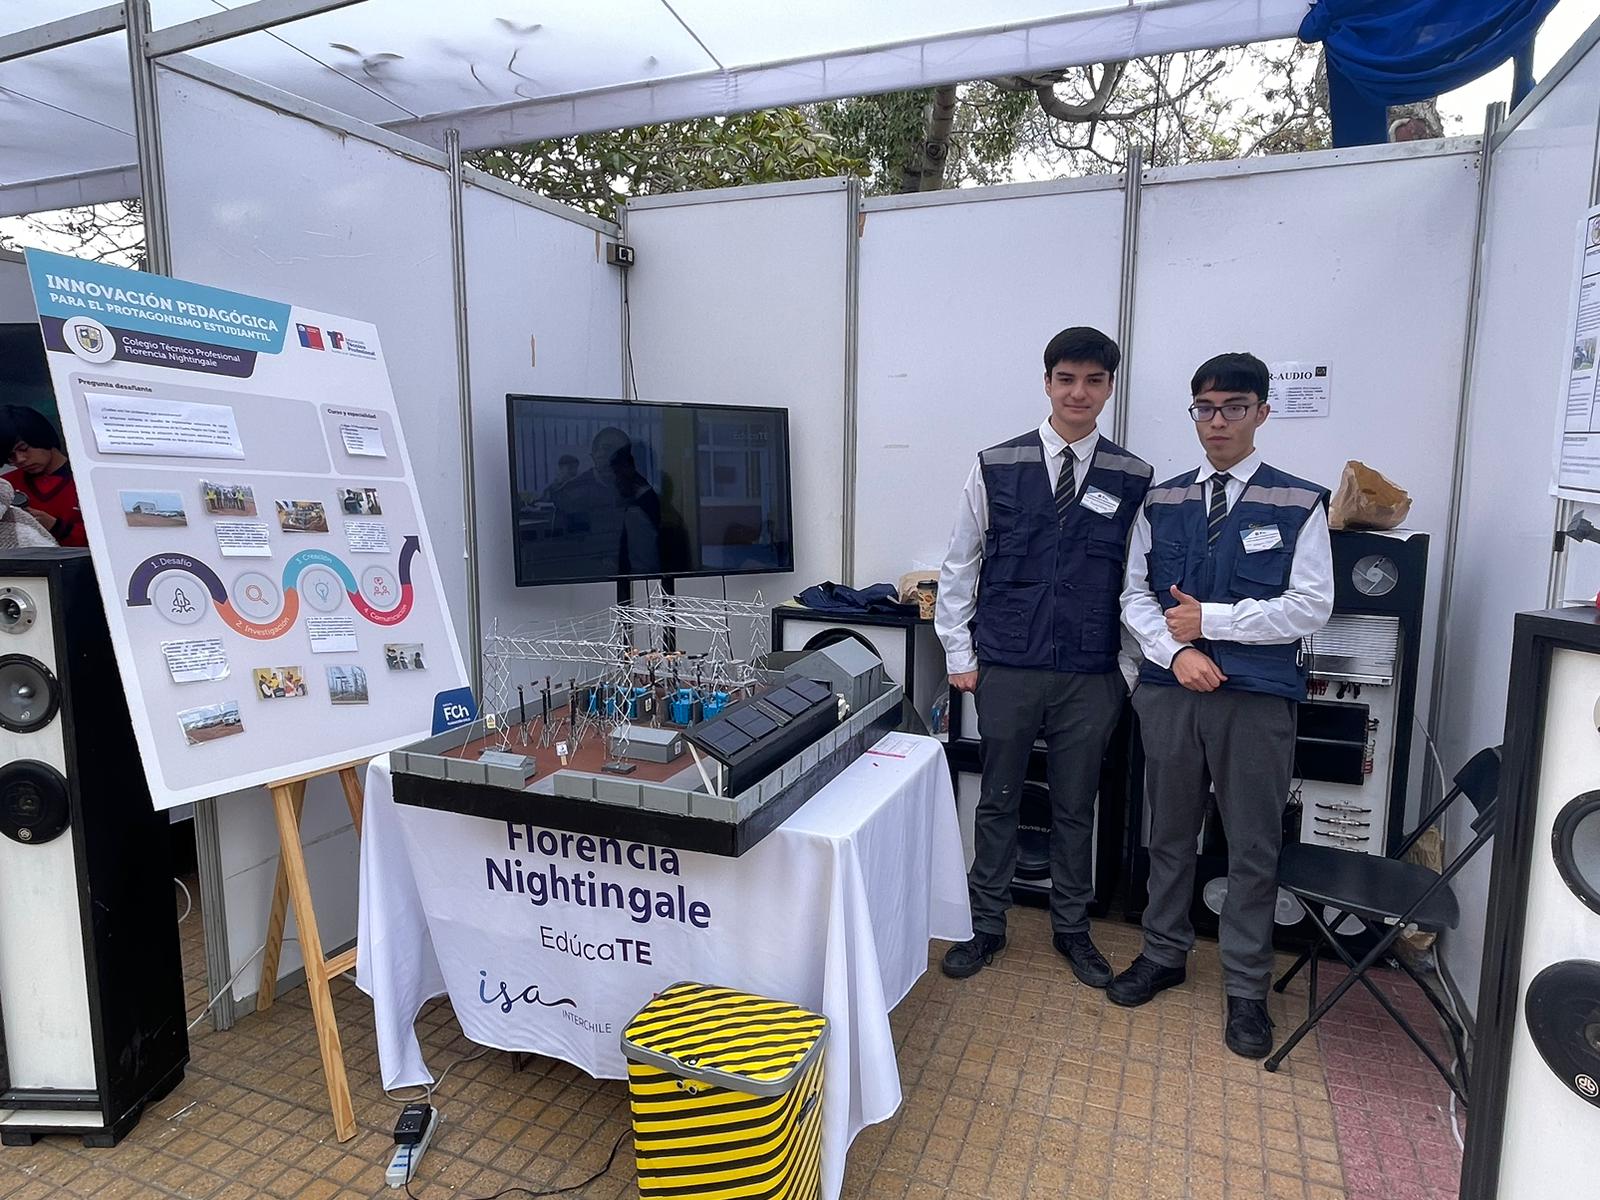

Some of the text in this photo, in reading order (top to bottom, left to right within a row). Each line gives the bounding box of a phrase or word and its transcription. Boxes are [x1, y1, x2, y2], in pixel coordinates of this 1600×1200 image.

[46, 274, 279, 332] INNOVACIÓN PEDAGÓGICA
[49, 293, 271, 342] PARA EL PROTAGONISMO ESTUDIANTIL
[122, 336, 241, 362] Colegio Técnico Profesional
[124, 345, 217, 367] Florencia Nightingale
[78, 378, 114, 388] Pregunta
[160, 557, 193, 568] Desafío
[244, 615, 290, 636] Investigación
[443, 704, 470, 721] FCh
[505, 820, 681, 876] Florencia
[485, 857, 712, 929] Nightingale
[540, 925, 653, 966] EdúcaTE
[479, 970, 577, 1014] isa
[562, 1009, 612, 1034] INTERCHILE
